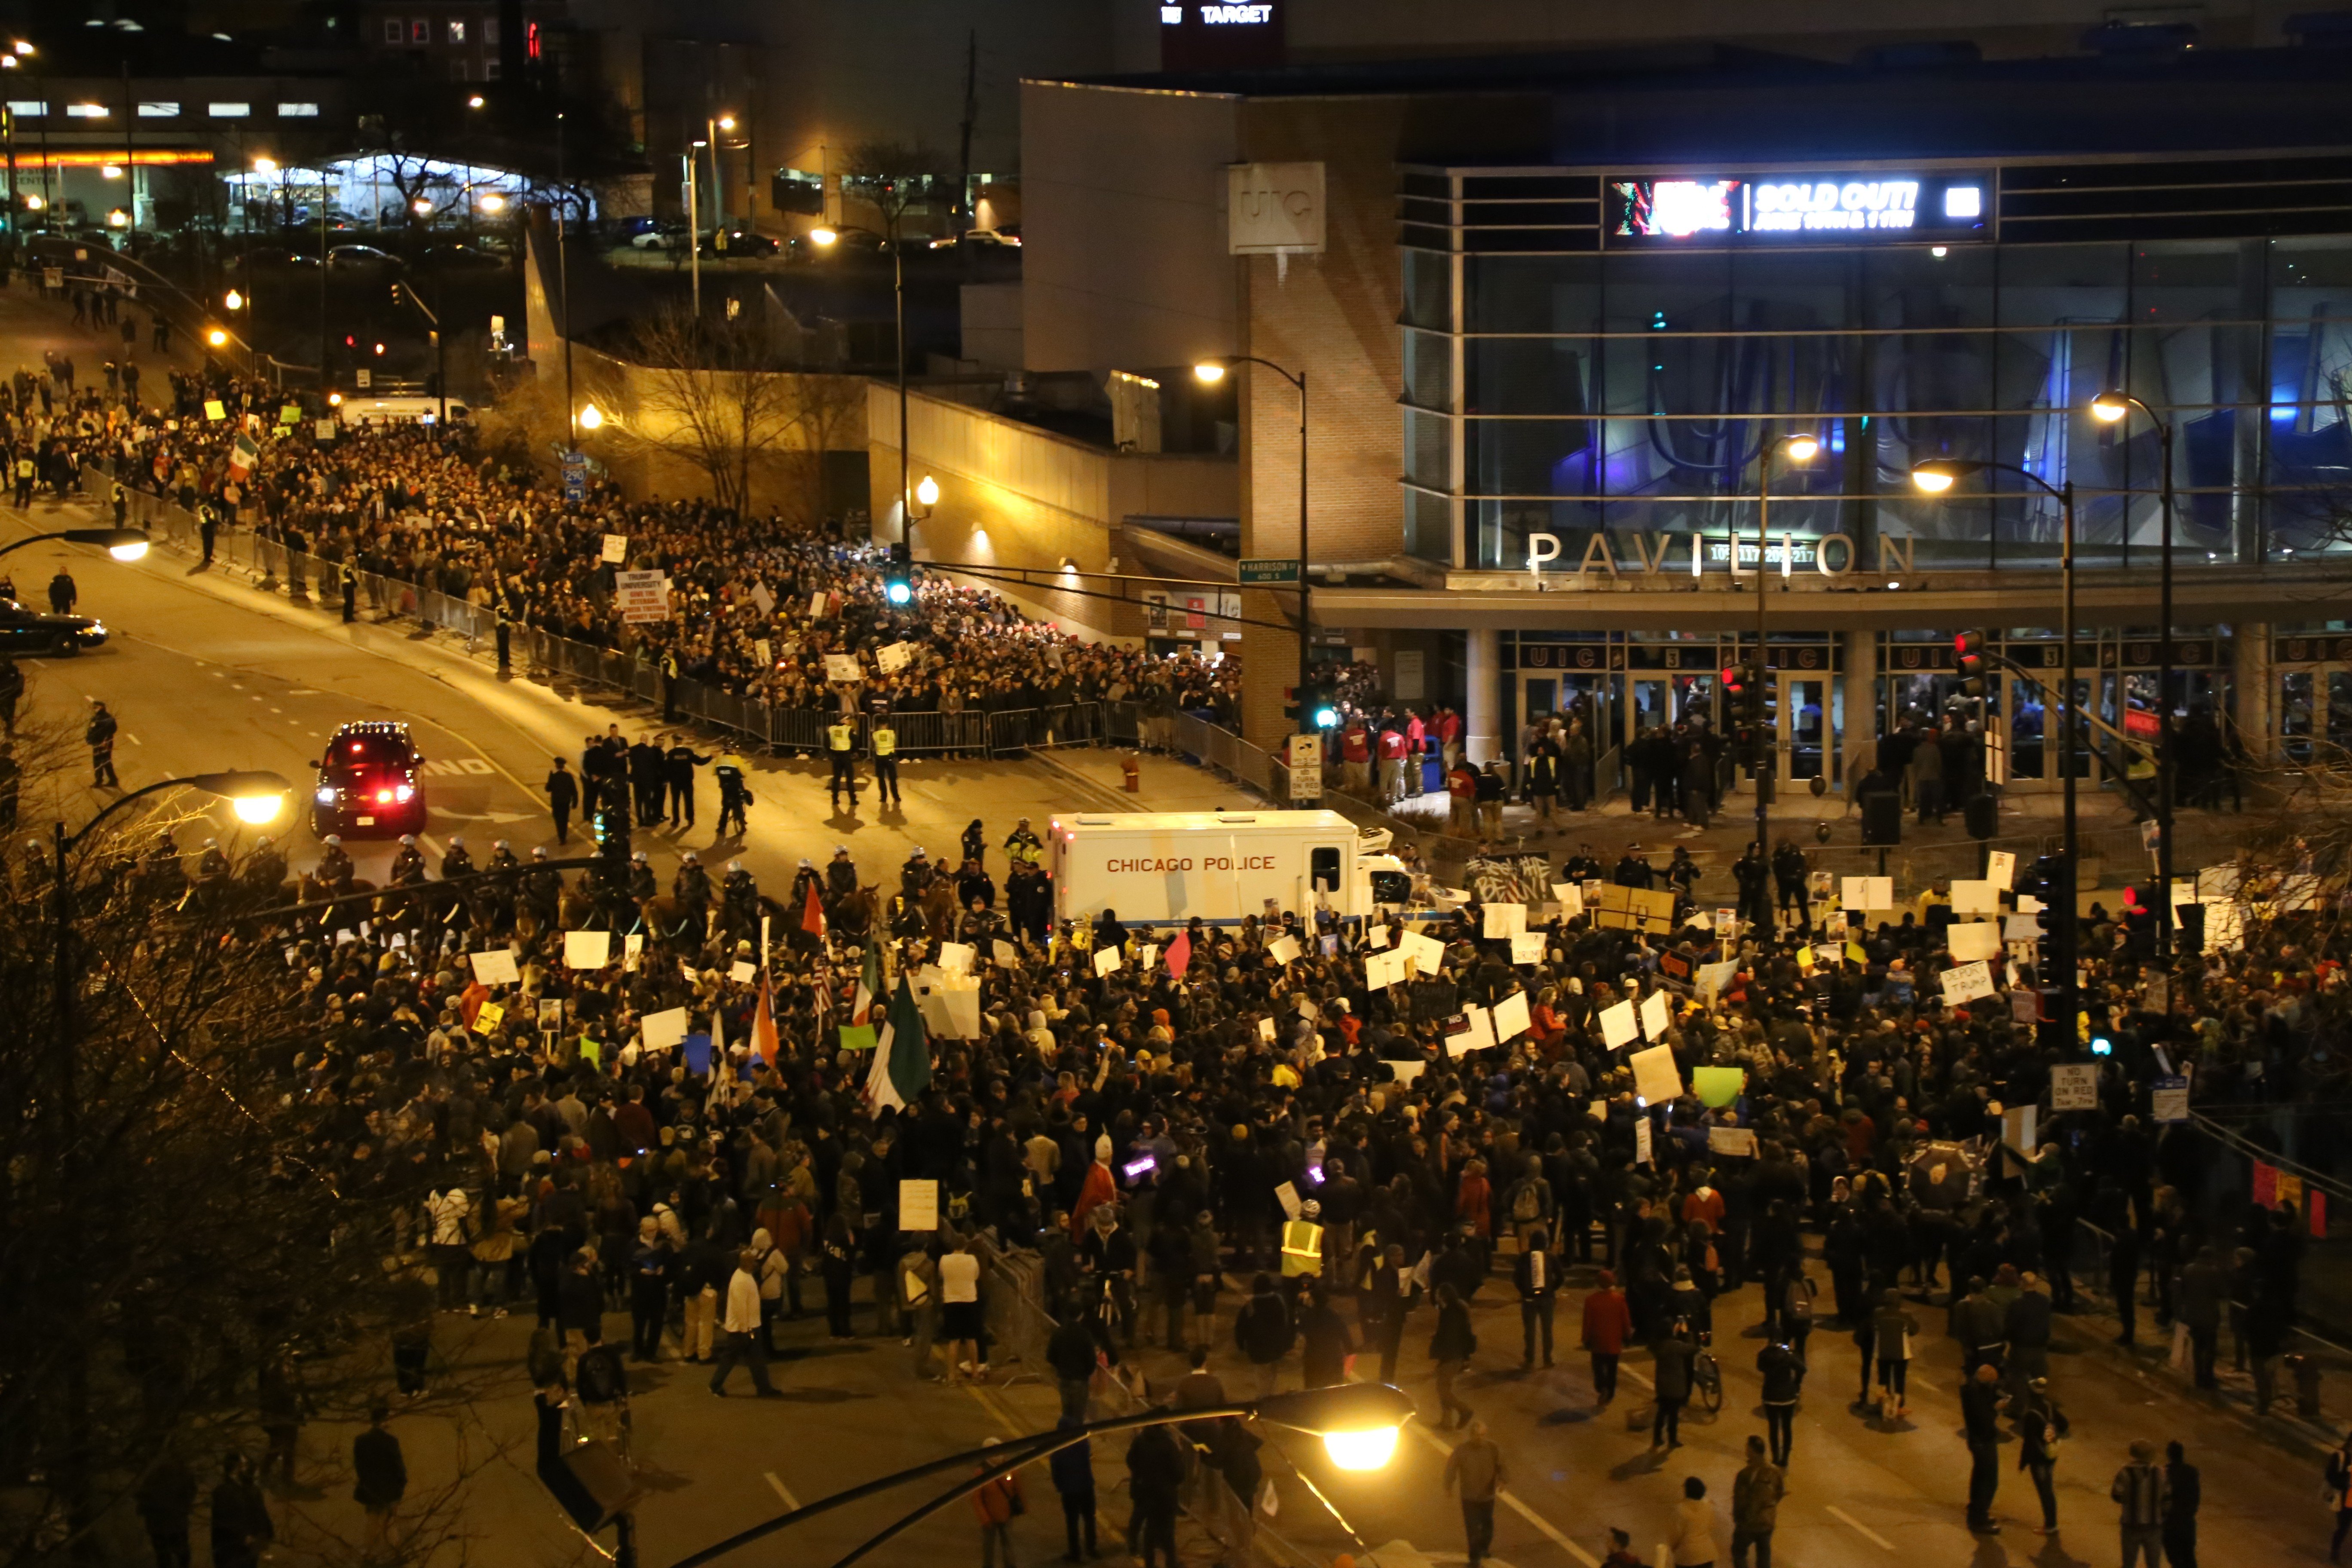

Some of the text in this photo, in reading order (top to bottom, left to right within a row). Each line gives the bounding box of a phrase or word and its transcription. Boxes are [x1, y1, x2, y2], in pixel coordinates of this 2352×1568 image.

[1201, 5, 1272, 23] TARGET
[1755, 184, 1839, 211] SOLD
[1841, 182, 1918, 210] OUT!
[1754, 211, 1802, 230] JUNE
[1847, 210, 1864, 229] &
[1866, 210, 1915, 229] 11TH
[566, 470, 584, 481] 290
[1528, 533, 1913, 577] PAVILION
[1247, 562, 1287, 571] HARRISON
[1530, 648, 1595, 667] UIC
[1668, 653, 1676, 667] 3
[2047, 650, 2055, 665] 3
[2131, 643, 2201, 664] UC
[1107, 856, 1276, 873] CHICAGO POLICE
[1944, 961, 1985, 981] DEPORT
[1951, 976, 1986, 992] TRUMP
[1448, 1015, 1463, 1025] NO
[2067, 1067, 2080, 1075] NO
[2061, 1077, 2088, 1086] TURN
[2055, 1086, 2092, 1095] ON RED
